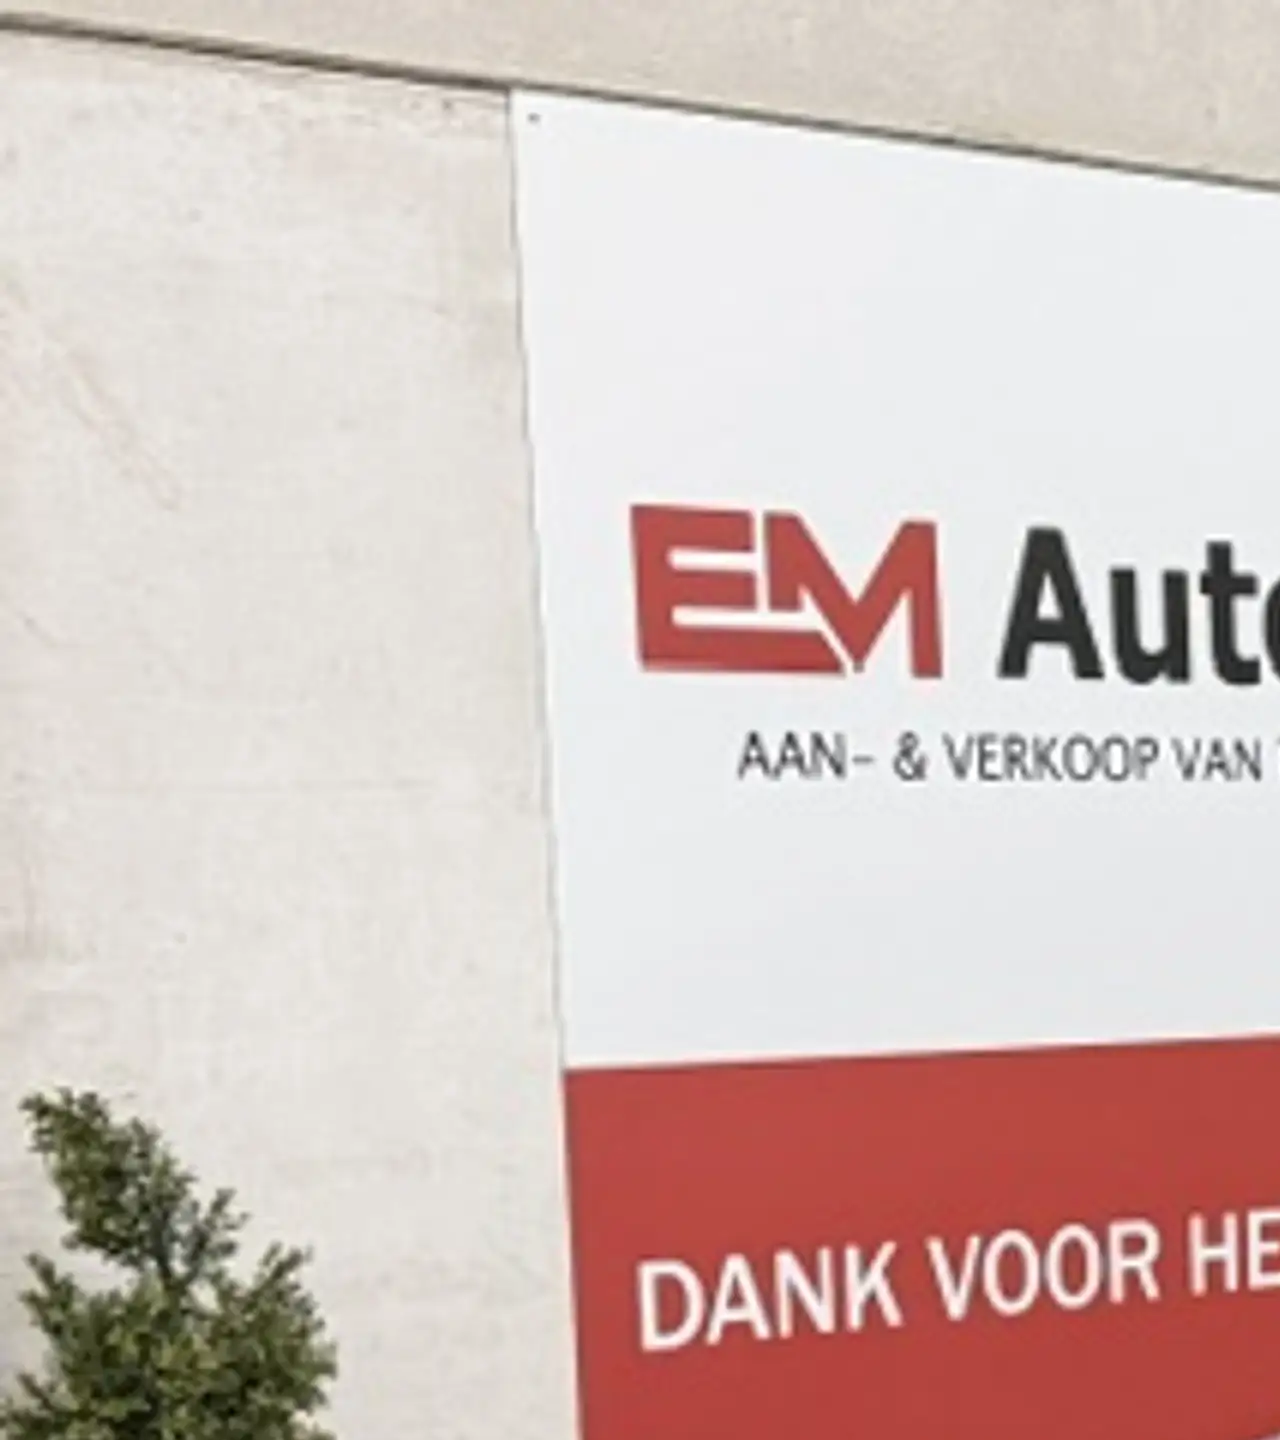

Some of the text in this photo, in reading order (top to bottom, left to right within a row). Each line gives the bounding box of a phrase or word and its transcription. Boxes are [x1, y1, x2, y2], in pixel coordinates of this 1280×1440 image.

[630, 503, 943, 677] EM
[737, 730, 875, 781] AAN-
[892, 730, 927, 783] &
[942, 733, 1161, 783] VERKOOP
[1171, 737, 1263, 783] VAN
[636, 1239, 903, 1353] DANK
[926, 1218, 1161, 1322] VOOR
